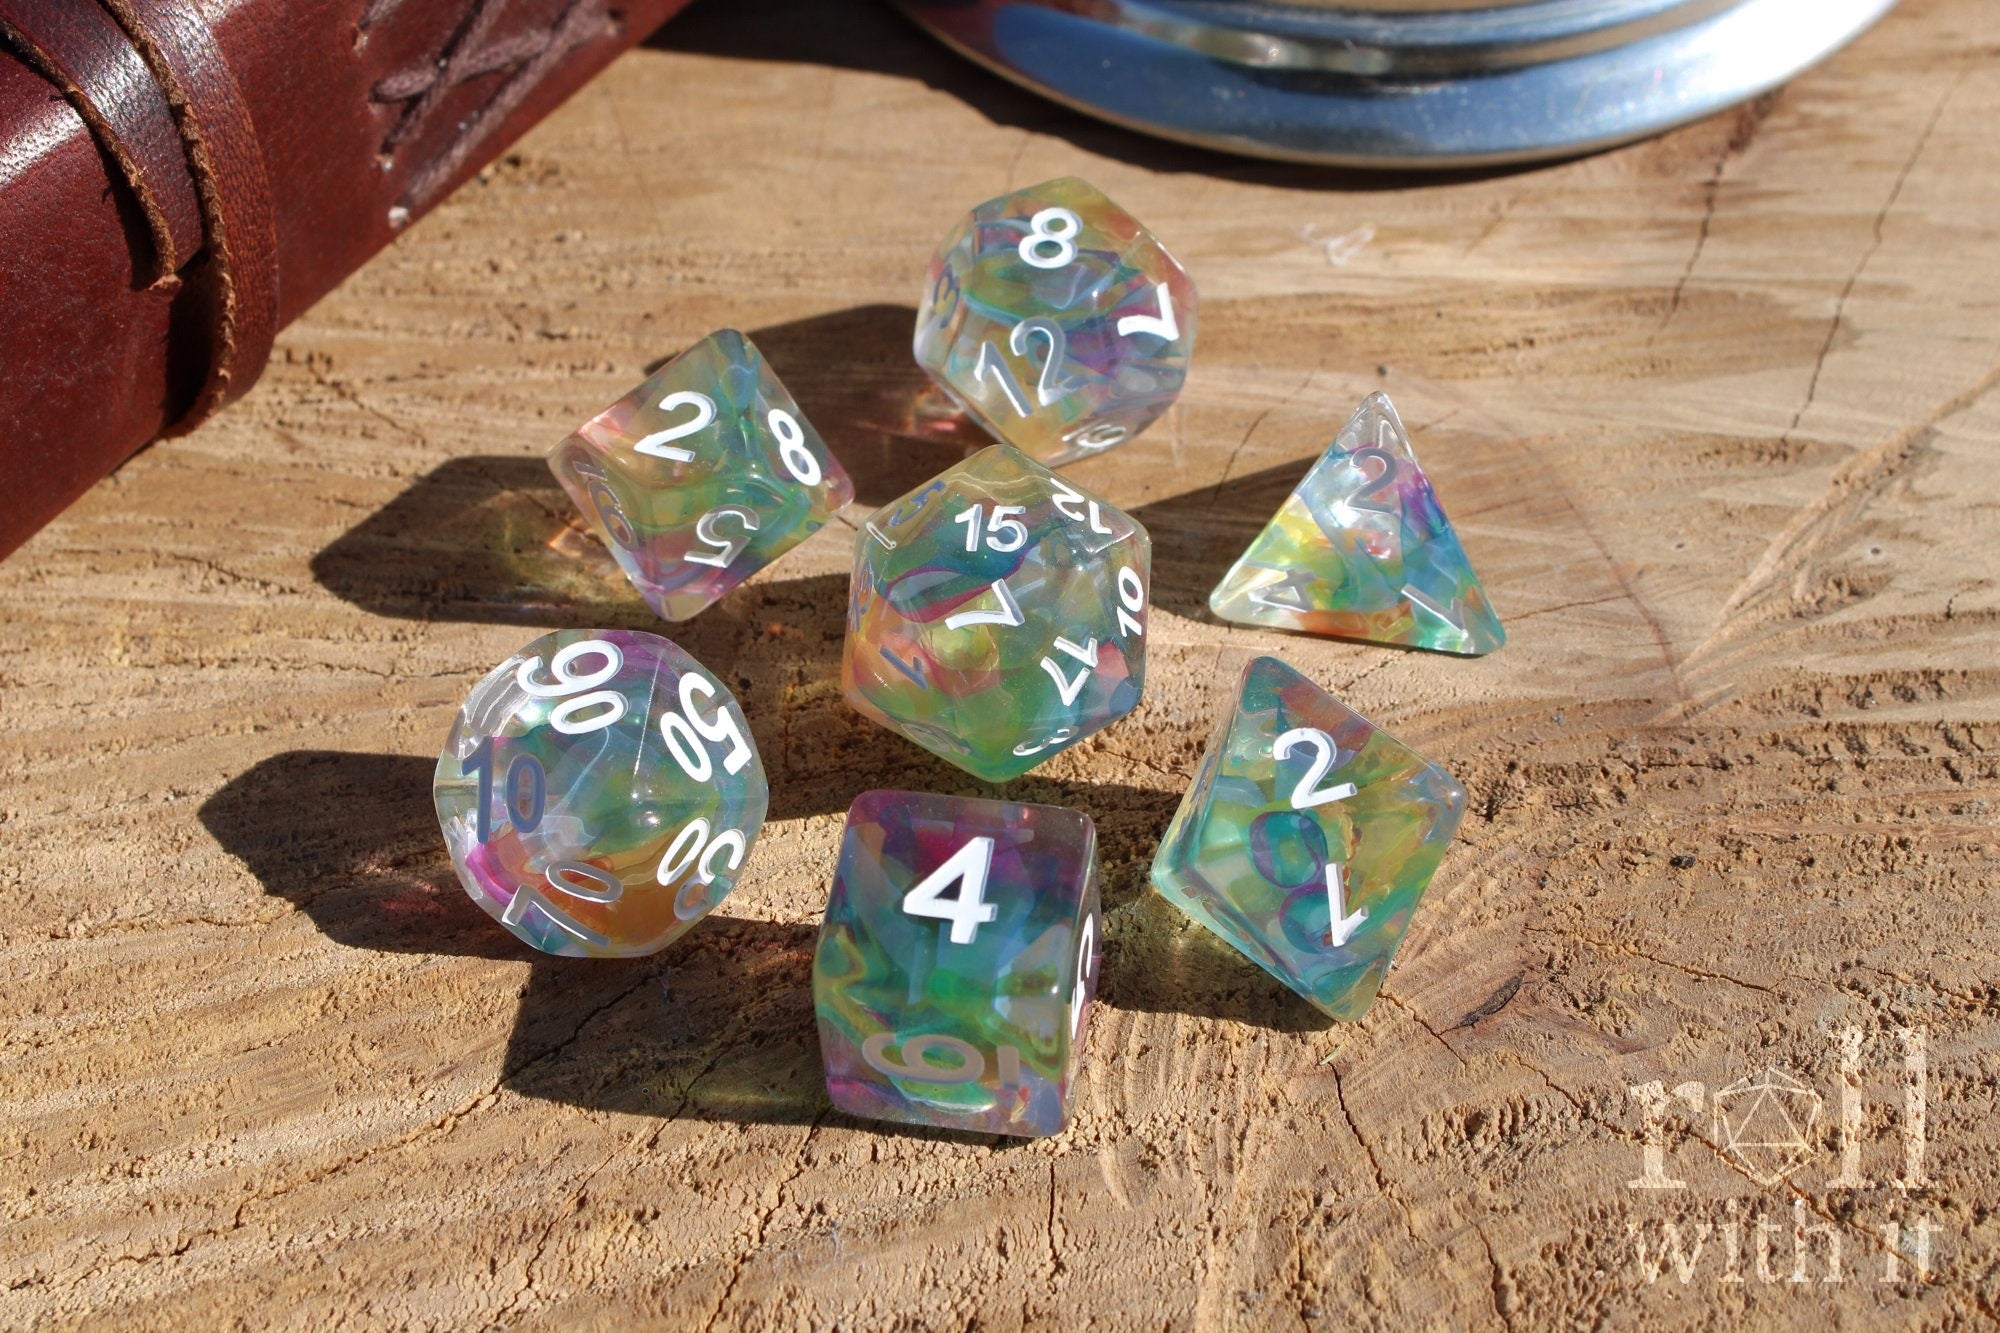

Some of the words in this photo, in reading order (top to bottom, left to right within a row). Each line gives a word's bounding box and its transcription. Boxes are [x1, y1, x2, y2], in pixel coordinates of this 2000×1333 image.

[1018, 207, 1083, 269] 8
[1117, 281, 1180, 341] 7
[974, 316, 1086, 418] 12
[633, 390, 717, 463] 2
[767, 408, 822, 487] 8
[1050, 477, 1112, 535] 12
[1344, 447, 1397, 516] 2
[684, 504, 760, 569] 5
[955, 503, 1029, 552] 15
[945, 578, 1025, 631] 7
[1117, 566, 1144, 638] 10
[1401, 582, 1468, 639] 1
[516, 639, 631, 735] 90
[1040, 636, 1099, 707] 17
[660, 671, 753, 783] 50
[462, 735, 546, 844] 10
[1273, 728, 1357, 809] 2
[903, 837, 999, 944] 4
[1325, 863, 1369, 946] 1
[862, 1033, 985, 1084] 6
